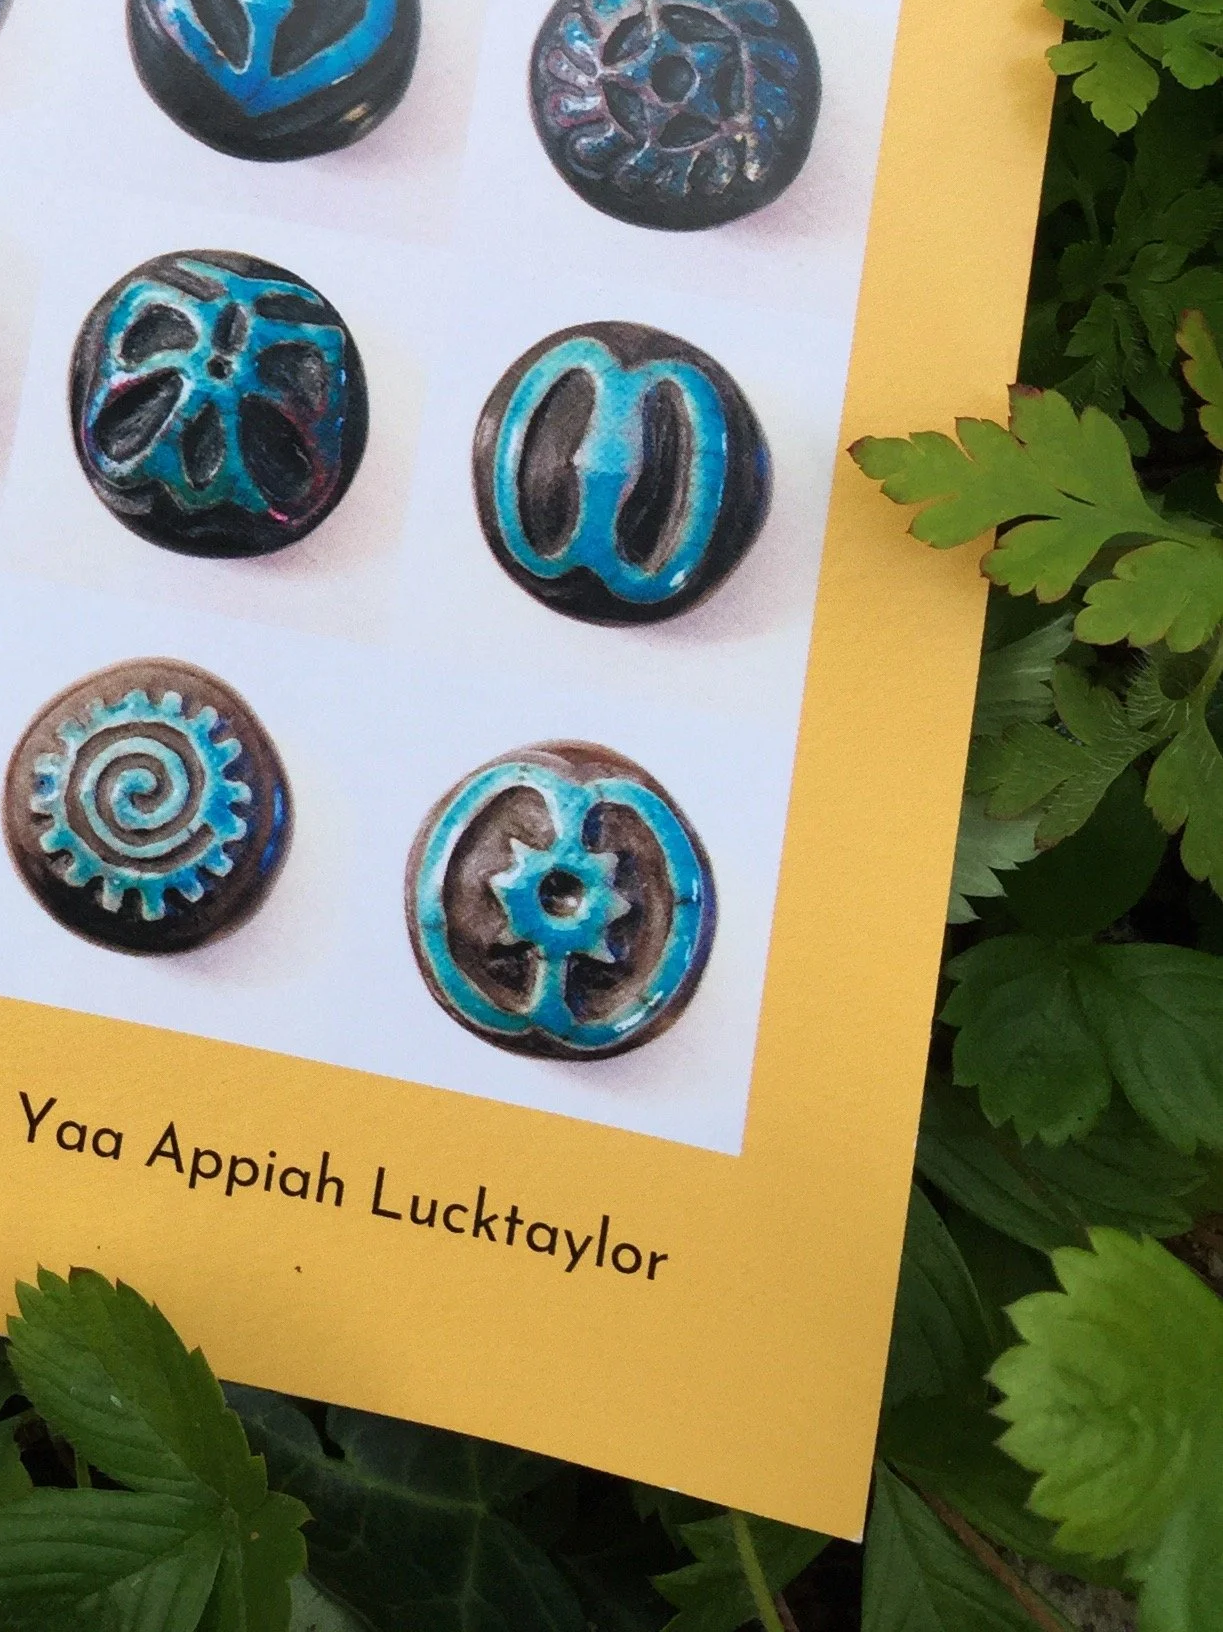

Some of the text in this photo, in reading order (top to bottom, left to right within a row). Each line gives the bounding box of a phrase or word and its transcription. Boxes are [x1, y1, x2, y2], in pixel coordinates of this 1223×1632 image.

[19, 1091, 124, 1161] Yaa
[144, 1121, 345, 1207] Appiah
[371, 1166, 669, 1281] Lucktaylor
